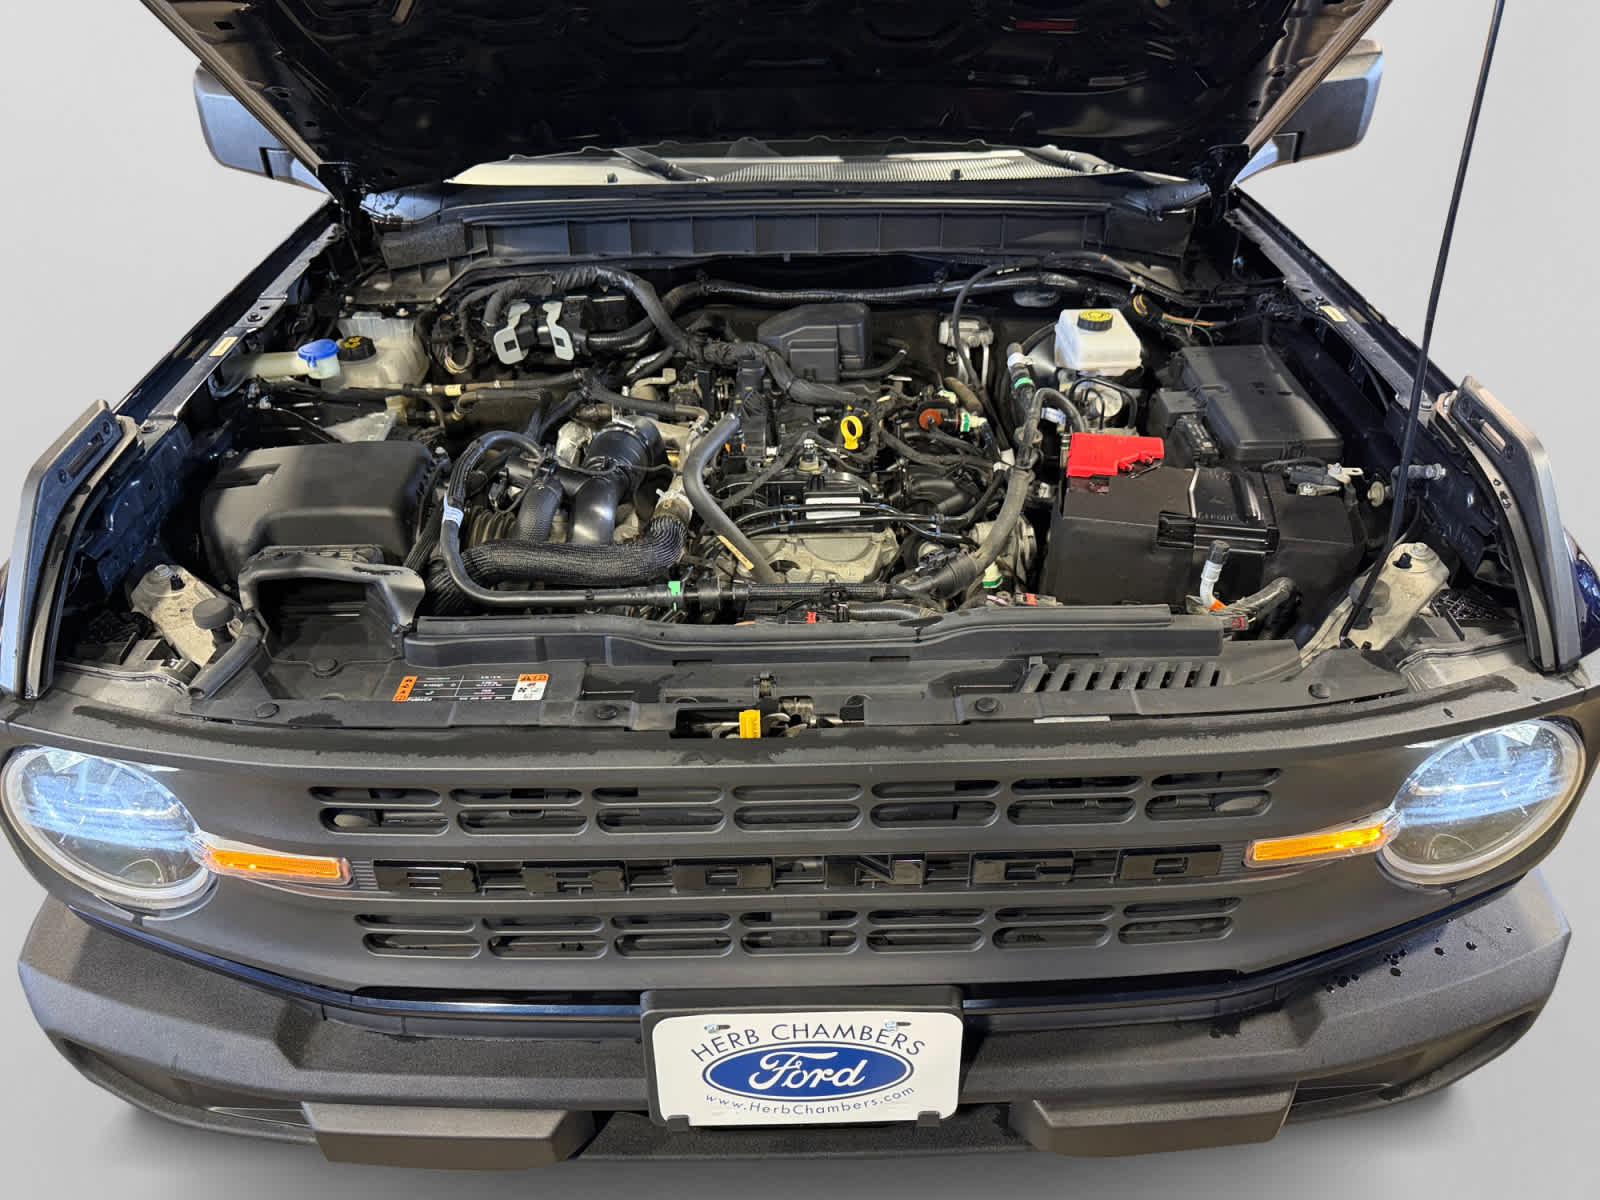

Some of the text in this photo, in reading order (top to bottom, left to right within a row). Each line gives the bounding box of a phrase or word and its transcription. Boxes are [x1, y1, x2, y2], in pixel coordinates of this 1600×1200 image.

[373, 846, 1222, 895] BRONCO
[690, 1023, 926, 1062] HERB CHAMBERS
[748, 1051, 868, 1090] Ford
[705, 1086, 915, 1115] www.HerbChambers.com
